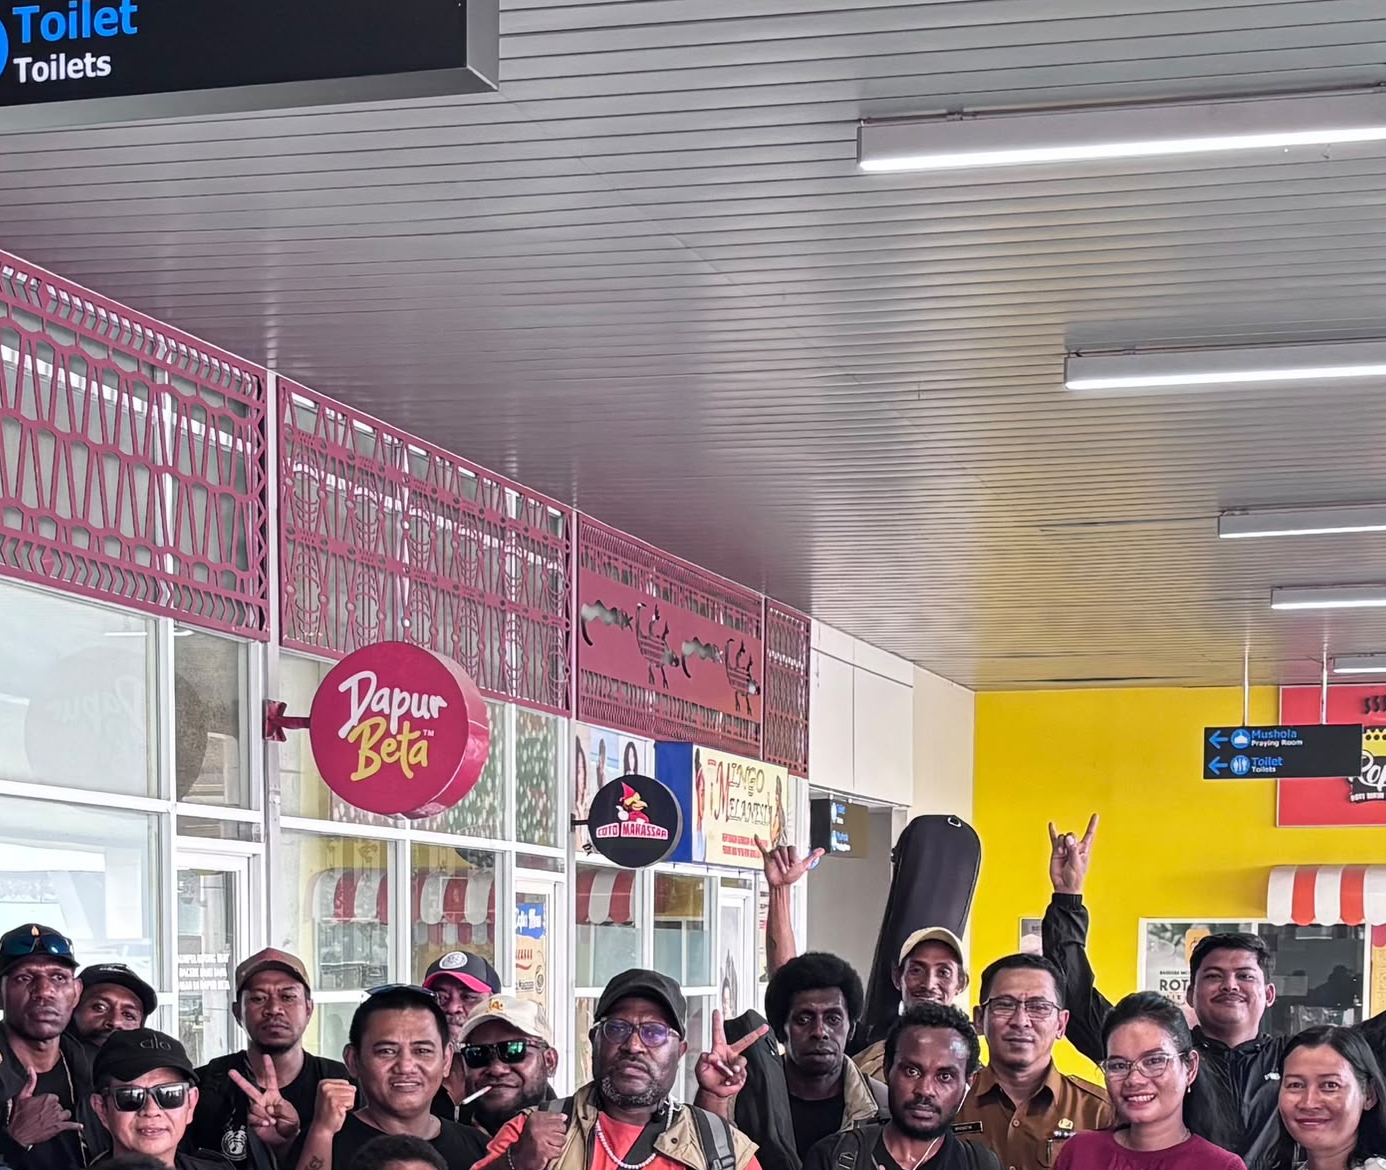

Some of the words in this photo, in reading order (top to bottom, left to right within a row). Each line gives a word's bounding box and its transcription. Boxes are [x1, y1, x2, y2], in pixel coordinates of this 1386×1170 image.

[13, 0, 137, 44] Toilet
[13, 52, 111, 84] Toilets
[338, 670, 448, 739] Dapur
[1251, 729, 1297, 739] Mushola
[1251, 740, 1279, 748] Praying
[1281, 739, 1303, 747] Room
[348, 716, 429, 782] Beta
[1251, 756, 1283, 767] Toilet
[1160, 979, 1188, 991] ROT
